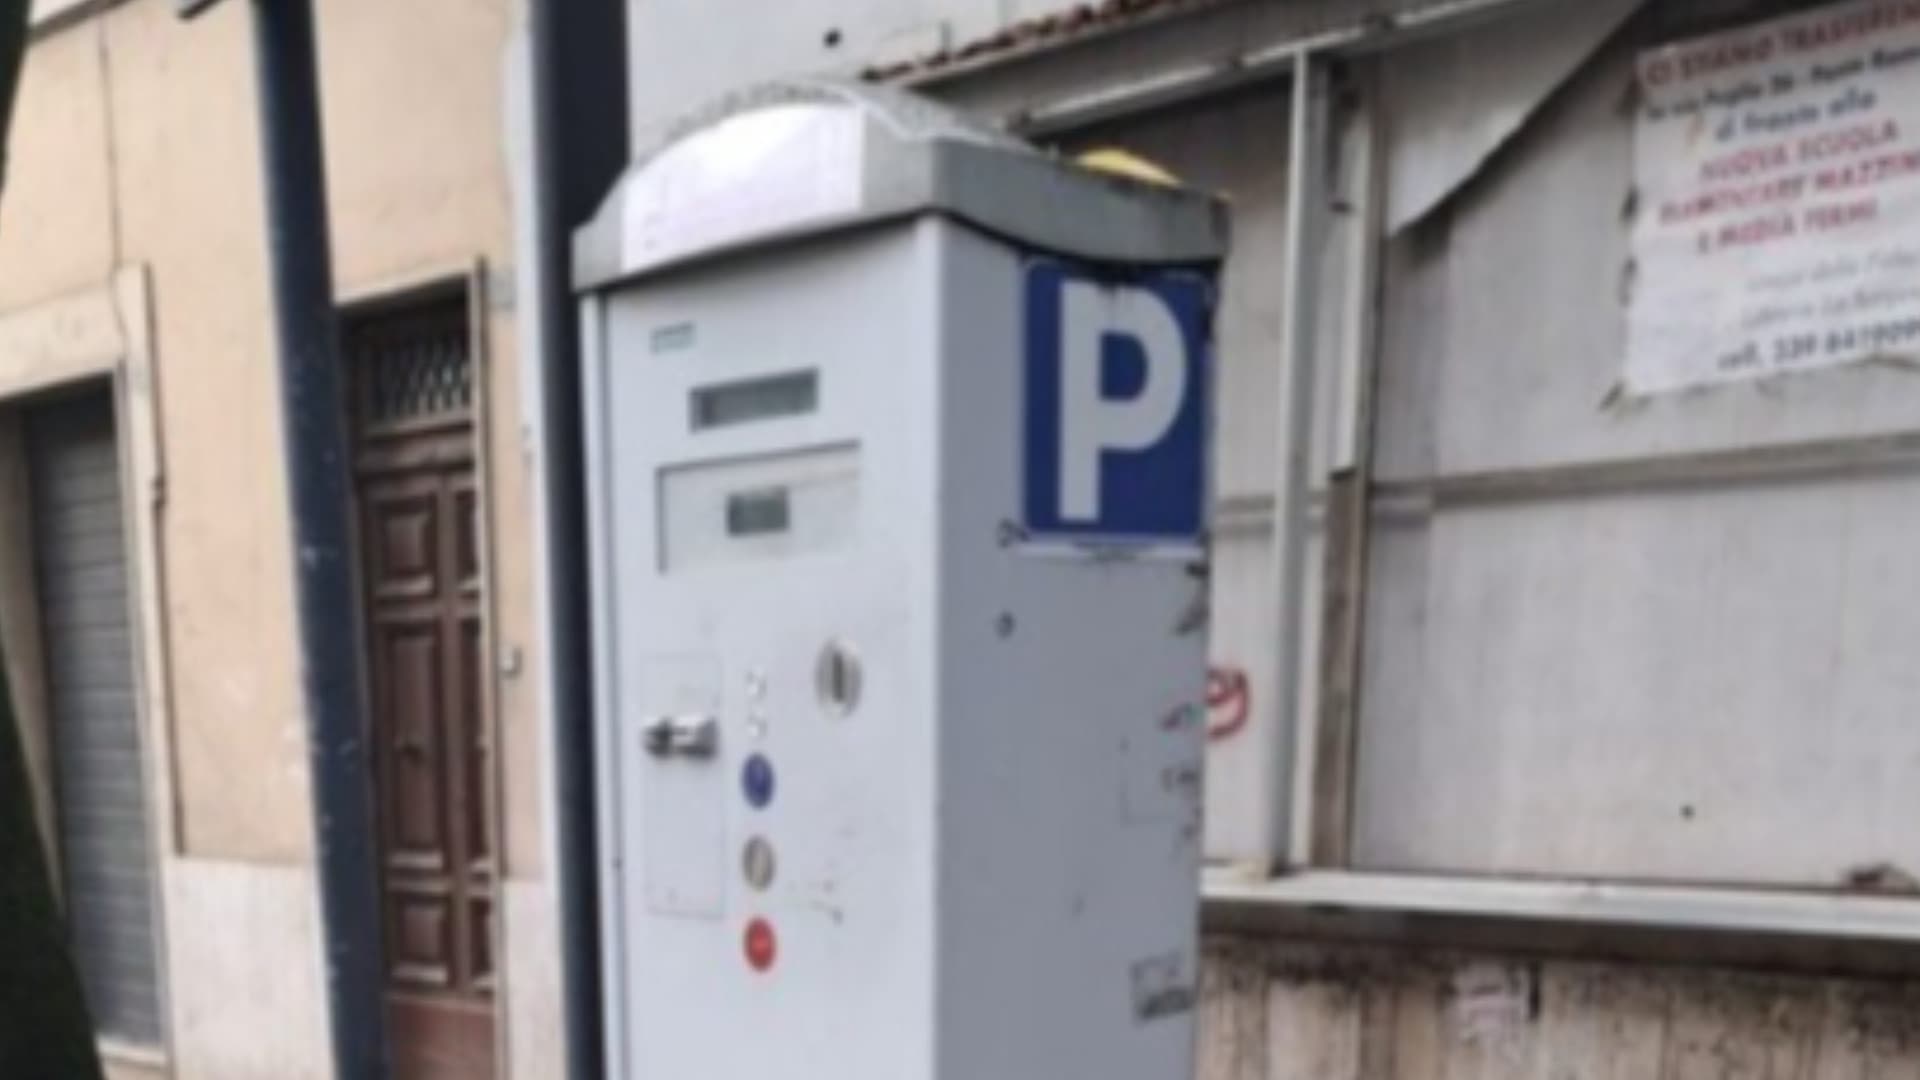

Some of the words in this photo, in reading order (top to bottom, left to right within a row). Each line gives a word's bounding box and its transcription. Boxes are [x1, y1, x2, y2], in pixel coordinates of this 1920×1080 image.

[1701, 144, 1789, 180] NUOVA
[1799, 118, 1898, 160] SCUOLA
[1060, 281, 1187, 519] P
